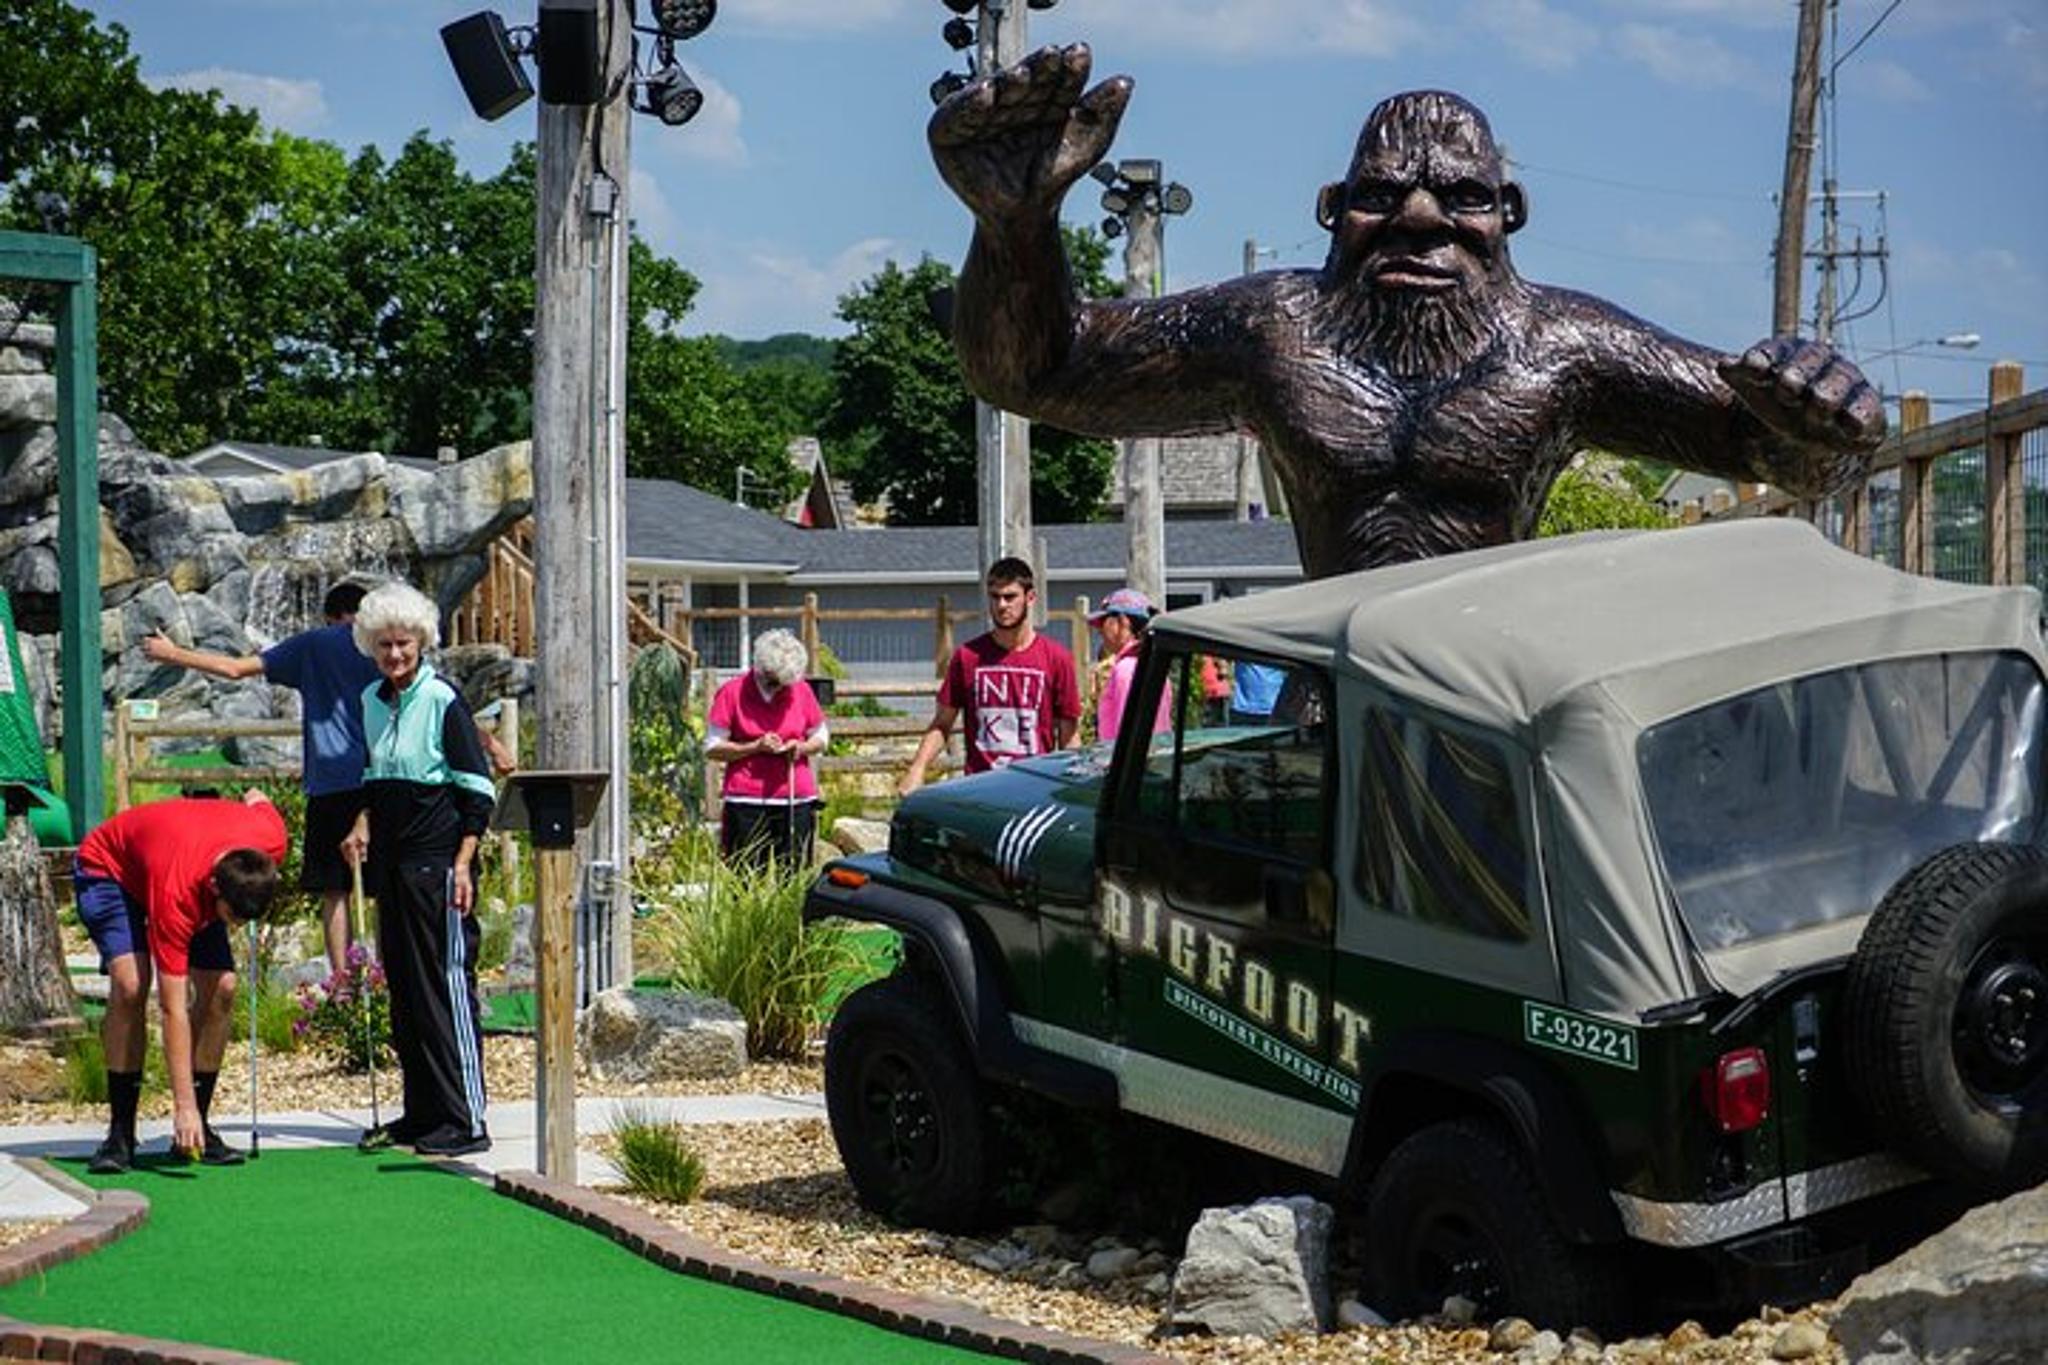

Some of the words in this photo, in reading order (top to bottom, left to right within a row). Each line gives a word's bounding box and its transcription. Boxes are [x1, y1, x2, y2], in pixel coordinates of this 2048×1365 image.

[1101, 879, 1370, 1068] BIGFOOT
[1173, 988, 1256, 1046] DISCOVERY
[1530, 1008, 1632, 1061] F-93221
